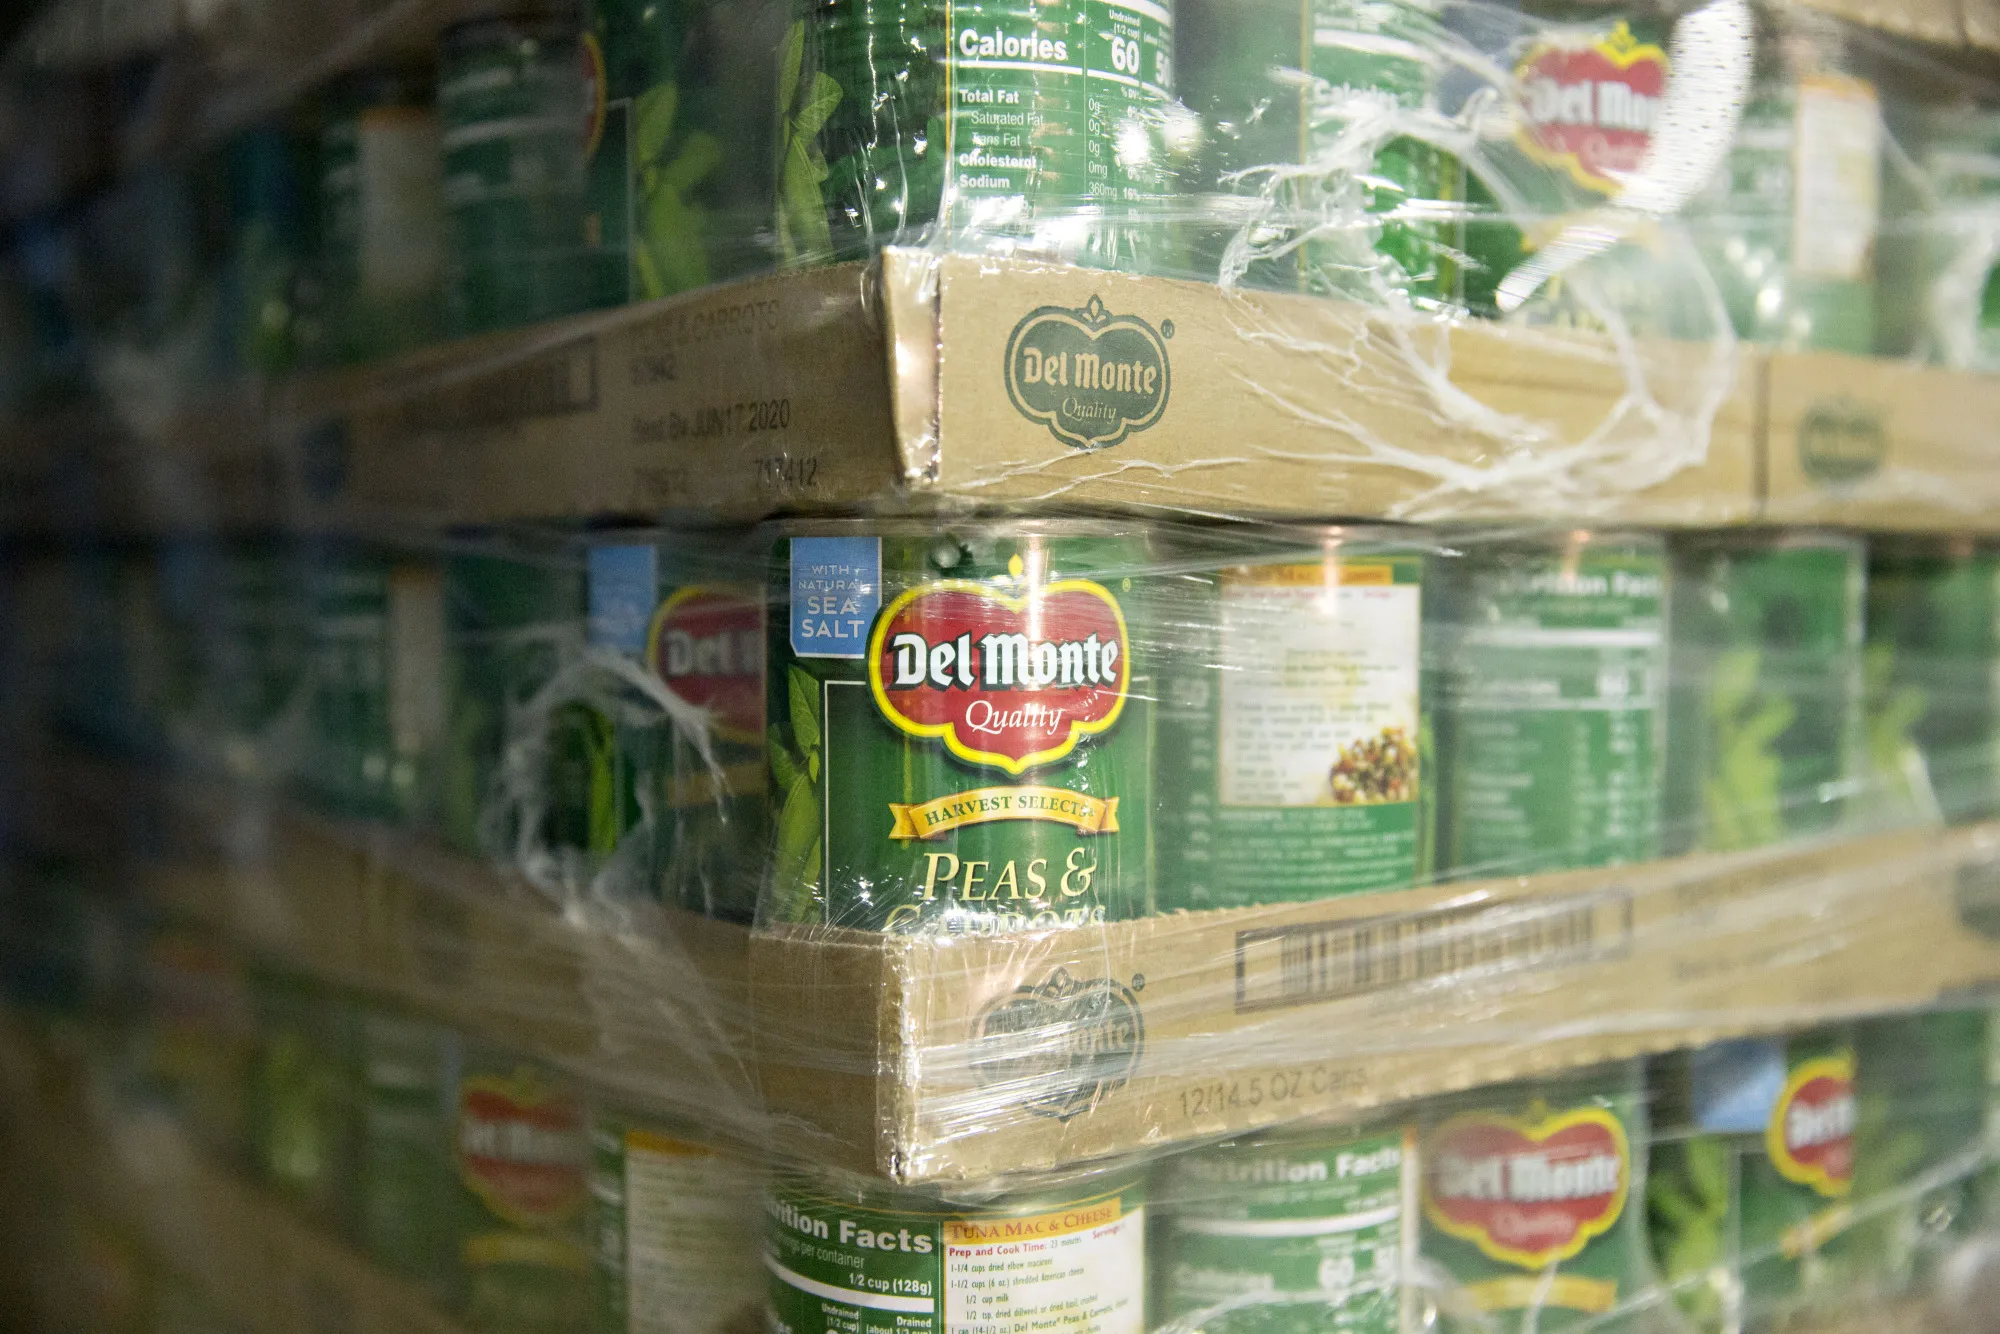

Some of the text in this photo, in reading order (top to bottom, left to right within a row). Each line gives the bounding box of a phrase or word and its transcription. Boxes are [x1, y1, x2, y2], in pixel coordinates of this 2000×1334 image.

[1109, 9, 1140, 27] Undrained
[959, 27, 1067, 61] Calories
[1111, 36, 1140, 75] 60
[959, 89, 1101, 115] Total Fat 0g
[971, 110, 1100, 136] Saturated Fat 0g
[972, 132, 1100, 157] Trans Fat 0g
[959, 153, 1037, 169] Cholesterol
[1088, 161, 1108, 179] 0mg
[959, 174, 1010, 189] Sodium
[1088, 182, 1118, 200] 360mg
[1023, 346, 1157, 394] Del Monte
[747, 398, 792, 433] 2020
[1062, 397, 1117, 424] Quality
[812, 565, 849, 576] WITH
[807, 596, 858, 615] SEA
[801, 619, 865, 639] SALT
[892, 631, 1120, 689] Del Monte
[965, 699, 1067, 736] Quality
[925, 796, 1012, 826] HARVEST
[917, 847, 1098, 901] PEAS &
[1270, 1070, 1303, 1101] OZ
[839, 1219, 934, 1254] Facts
[951, 1222, 1000, 1240] TUNA
[1005, 1221, 1045, 1237] MAC
[1049, 1219, 1059, 1232] &
[817, 1246, 865, 1270] container
[949, 1247, 972, 1259] Prep
[975, 1247, 993, 1257] and
[997, 1245, 1020, 1255] Cook
[1024, 1243, 1048, 1253] Time:
[950, 1263, 968, 1274] 1-1/4
[971, 1264, 985, 1275] cups
[988, 1261, 1005, 1272] dried
[1007, 1260, 1025, 1271] elbow
[849, 1273, 932, 1296] 1/2 cup (128g)
[950, 1279, 968, 1289] 1-1/2
[971, 1281, 986, 1292] cups
[1012, 1273, 1039, 1286] shredded
[821, 1302, 859, 1321] Undrained
[966, 1292, 1009, 1308] 1/2 cup milk
[896, 1315, 932, 1329] Drained
[966, 1310, 977, 1320] 1/2
[995, 1308, 1011, 1319] dried
[1014, 1321, 1028, 1333] Del
[1063, 1314, 1080, 1325] Peas
